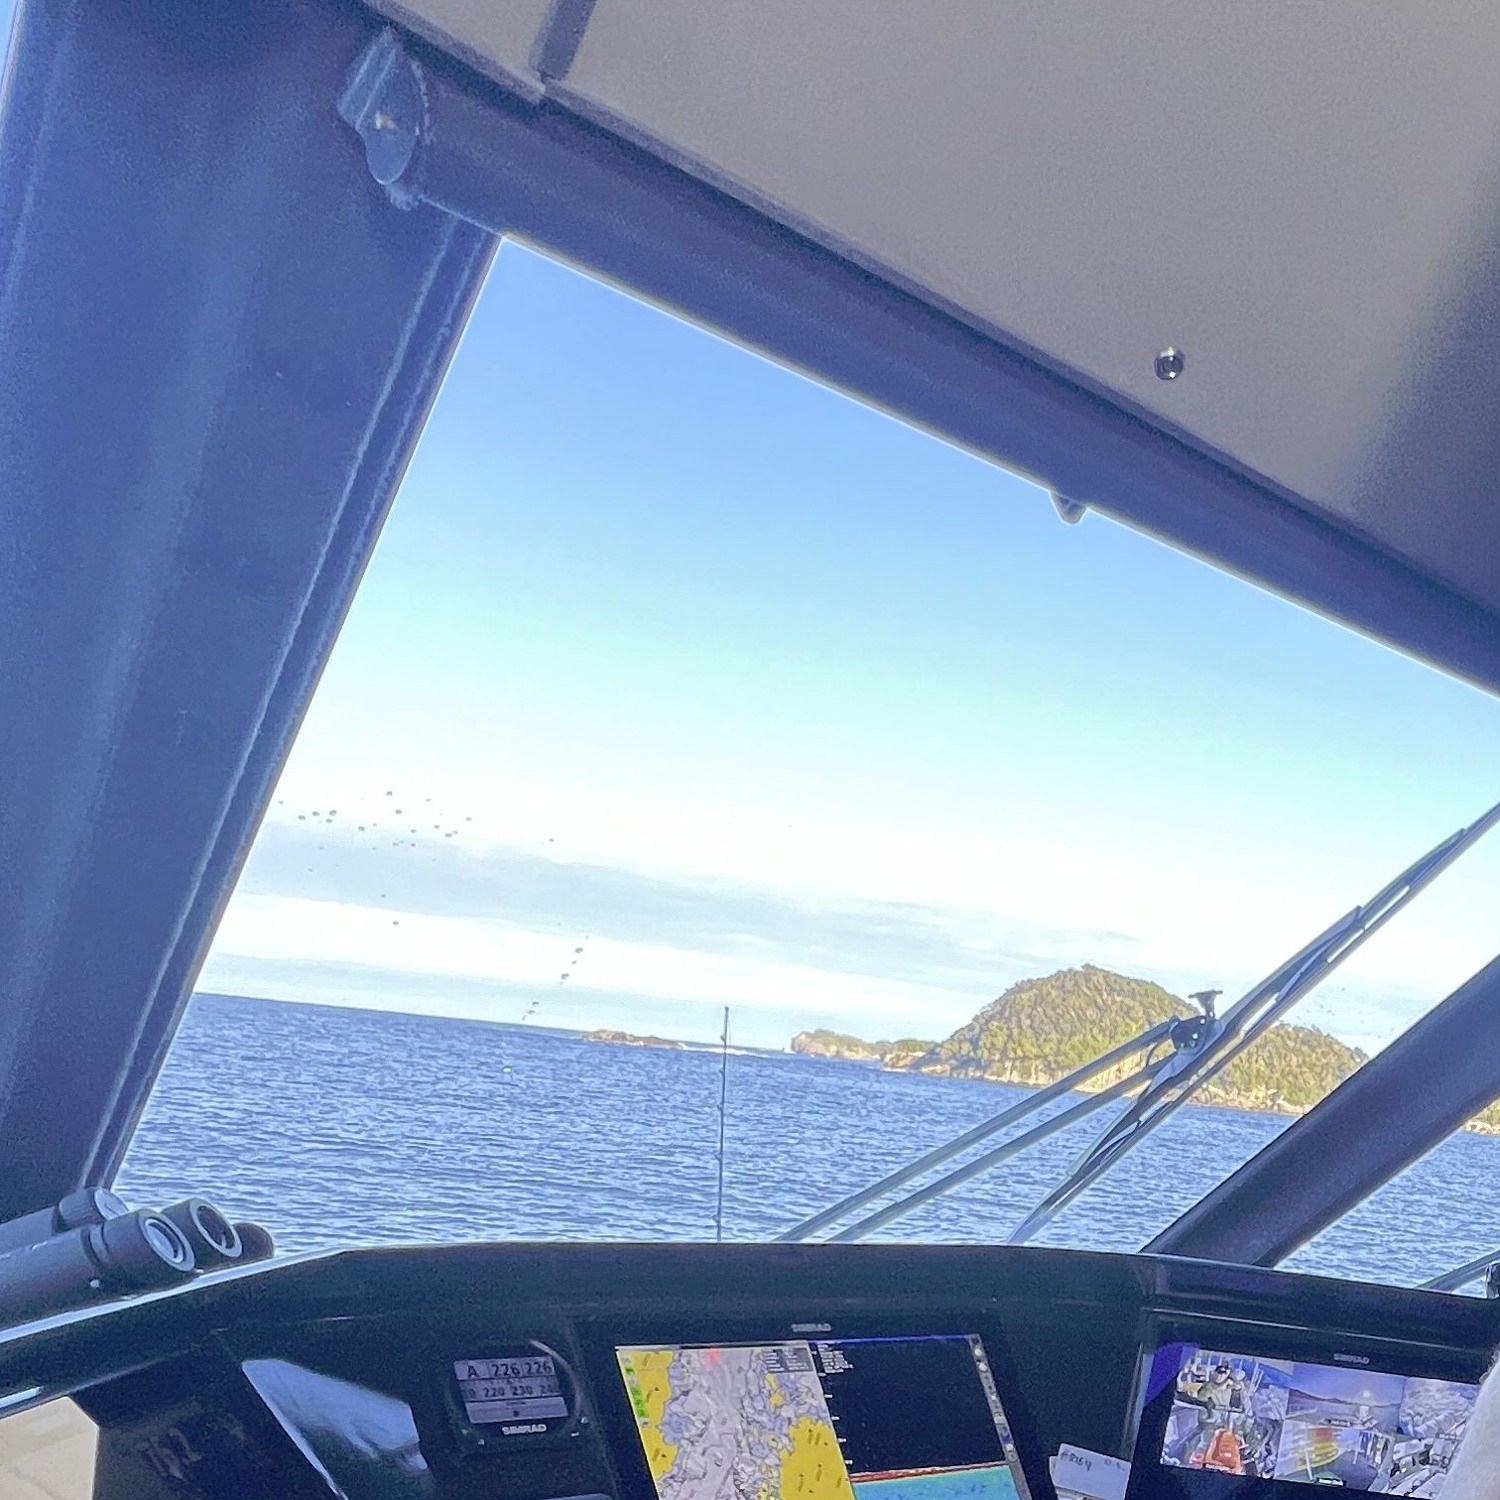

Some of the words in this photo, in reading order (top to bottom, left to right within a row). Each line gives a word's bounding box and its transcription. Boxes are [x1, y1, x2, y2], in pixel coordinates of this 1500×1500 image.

[467, 1365, 479, 1378] A
[491, 1363, 521, 1378] 226
[525, 1360, 553, 1377] 226
[501, 1423, 548, 1436] SIMRAD
